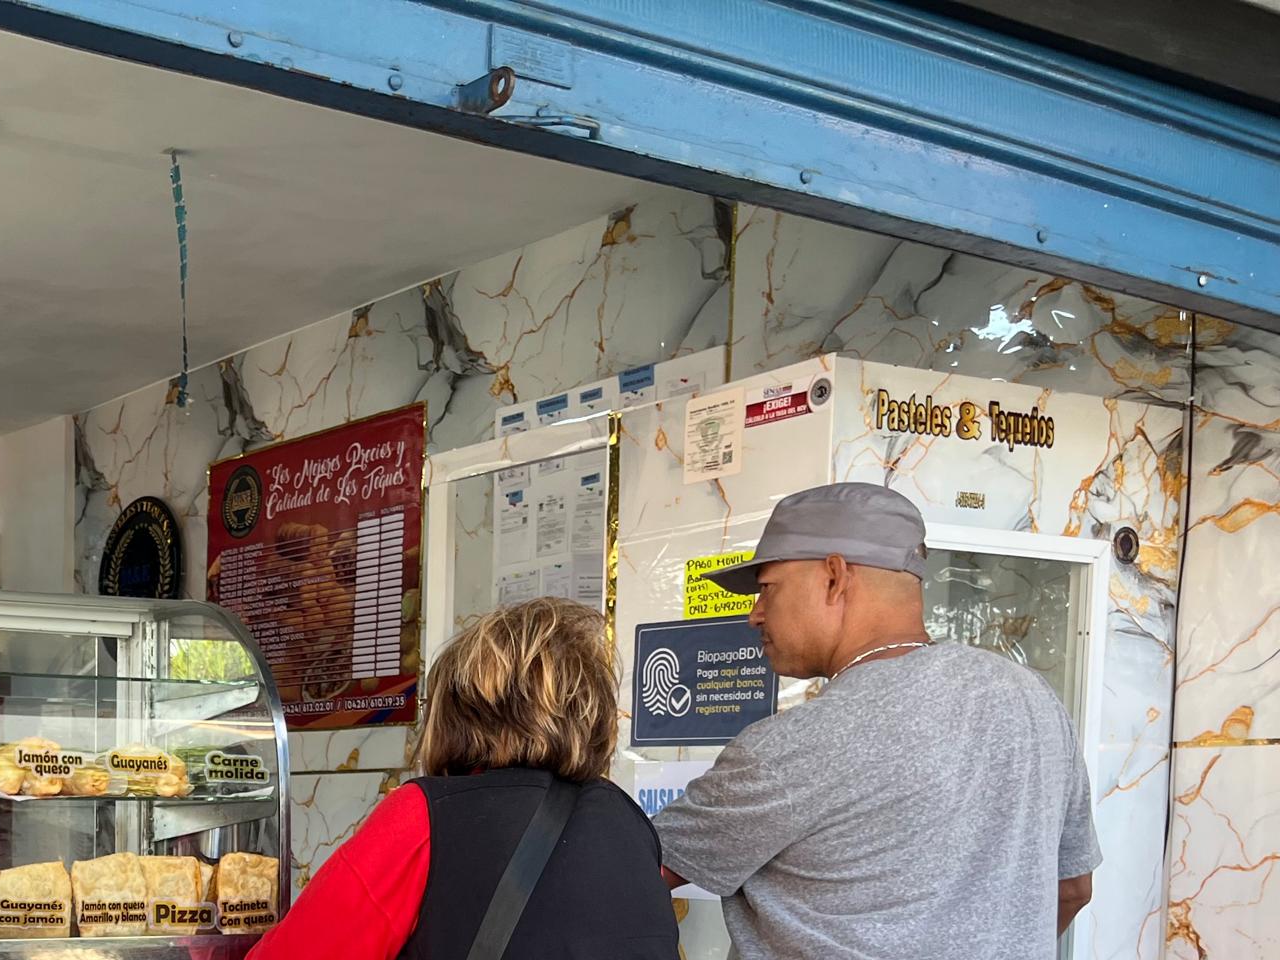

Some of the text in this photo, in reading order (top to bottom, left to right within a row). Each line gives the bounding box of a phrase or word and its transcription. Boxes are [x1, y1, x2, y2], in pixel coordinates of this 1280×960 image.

[876, 389, 952, 437] Pasteles
[956, 401, 982, 440] &
[989, 401, 1055, 452] Tequeños
[294, 455, 341, 488] Mejores
[345, 442, 392, 480] Precios
[397, 441, 405, 467] y
[266, 486, 312, 519] Calidad
[316, 484, 330, 503] de
[335, 477, 357, 505] Los
[686, 559, 712, 571] PAGO
[697, 646, 765, 664] BiopagoBDV
[740, 665, 767, 676] desde
[696, 680, 735, 691] cualquier
[696, 689, 766, 702] sin necesidad de
[695, 704, 741, 715] registrarte
[18, 750, 83, 766] Jamón con
[111, 755, 168, 772] Guayanés
[210, 754, 259, 768] Carne
[34, 763, 70, 776] queso
[209, 767, 265, 780] molida
[0, 900, 63, 912] Guayanés
[81, 900, 145, 912] Jamón con queso
[222, 900, 269, 912] Tocineta
[0, 912, 64, 925] con jamón
[80, 912, 147, 925] Amarillo y blanco
[155, 904, 212, 924] Pizza
[220, 914, 275, 926] Con queso
